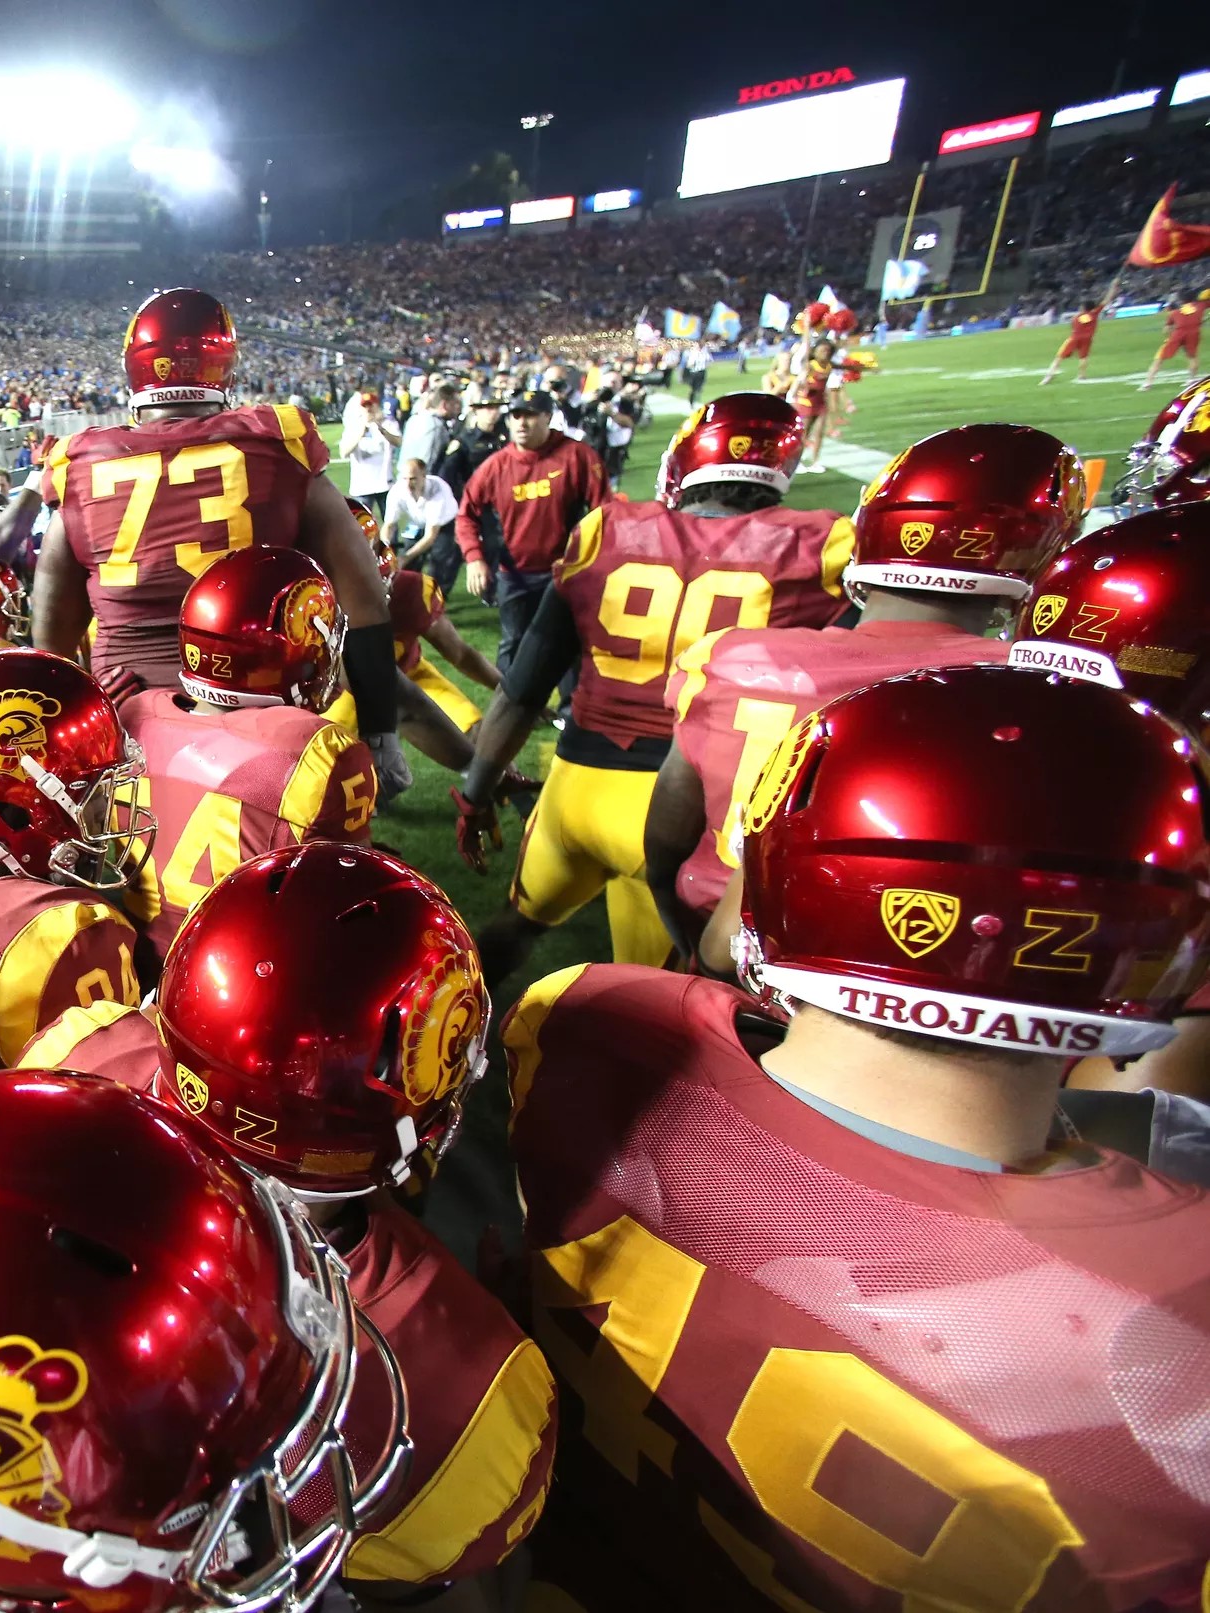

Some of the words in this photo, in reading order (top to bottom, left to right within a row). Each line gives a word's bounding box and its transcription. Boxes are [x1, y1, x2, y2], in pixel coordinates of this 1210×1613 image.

[737, 67, 856, 105] HONDA
[150, 388, 206, 403] TROJANS
[720, 468, 776, 483] TROJANS
[91, 441, 254, 587] 73
[881, 572, 979, 591] TROJANS
[591, 562, 774, 685] 90
[1013, 648, 1103, 677] TROJANS
[898, 918, 936, 944] 12
[839, 986, 1106, 1052] TROJANS
